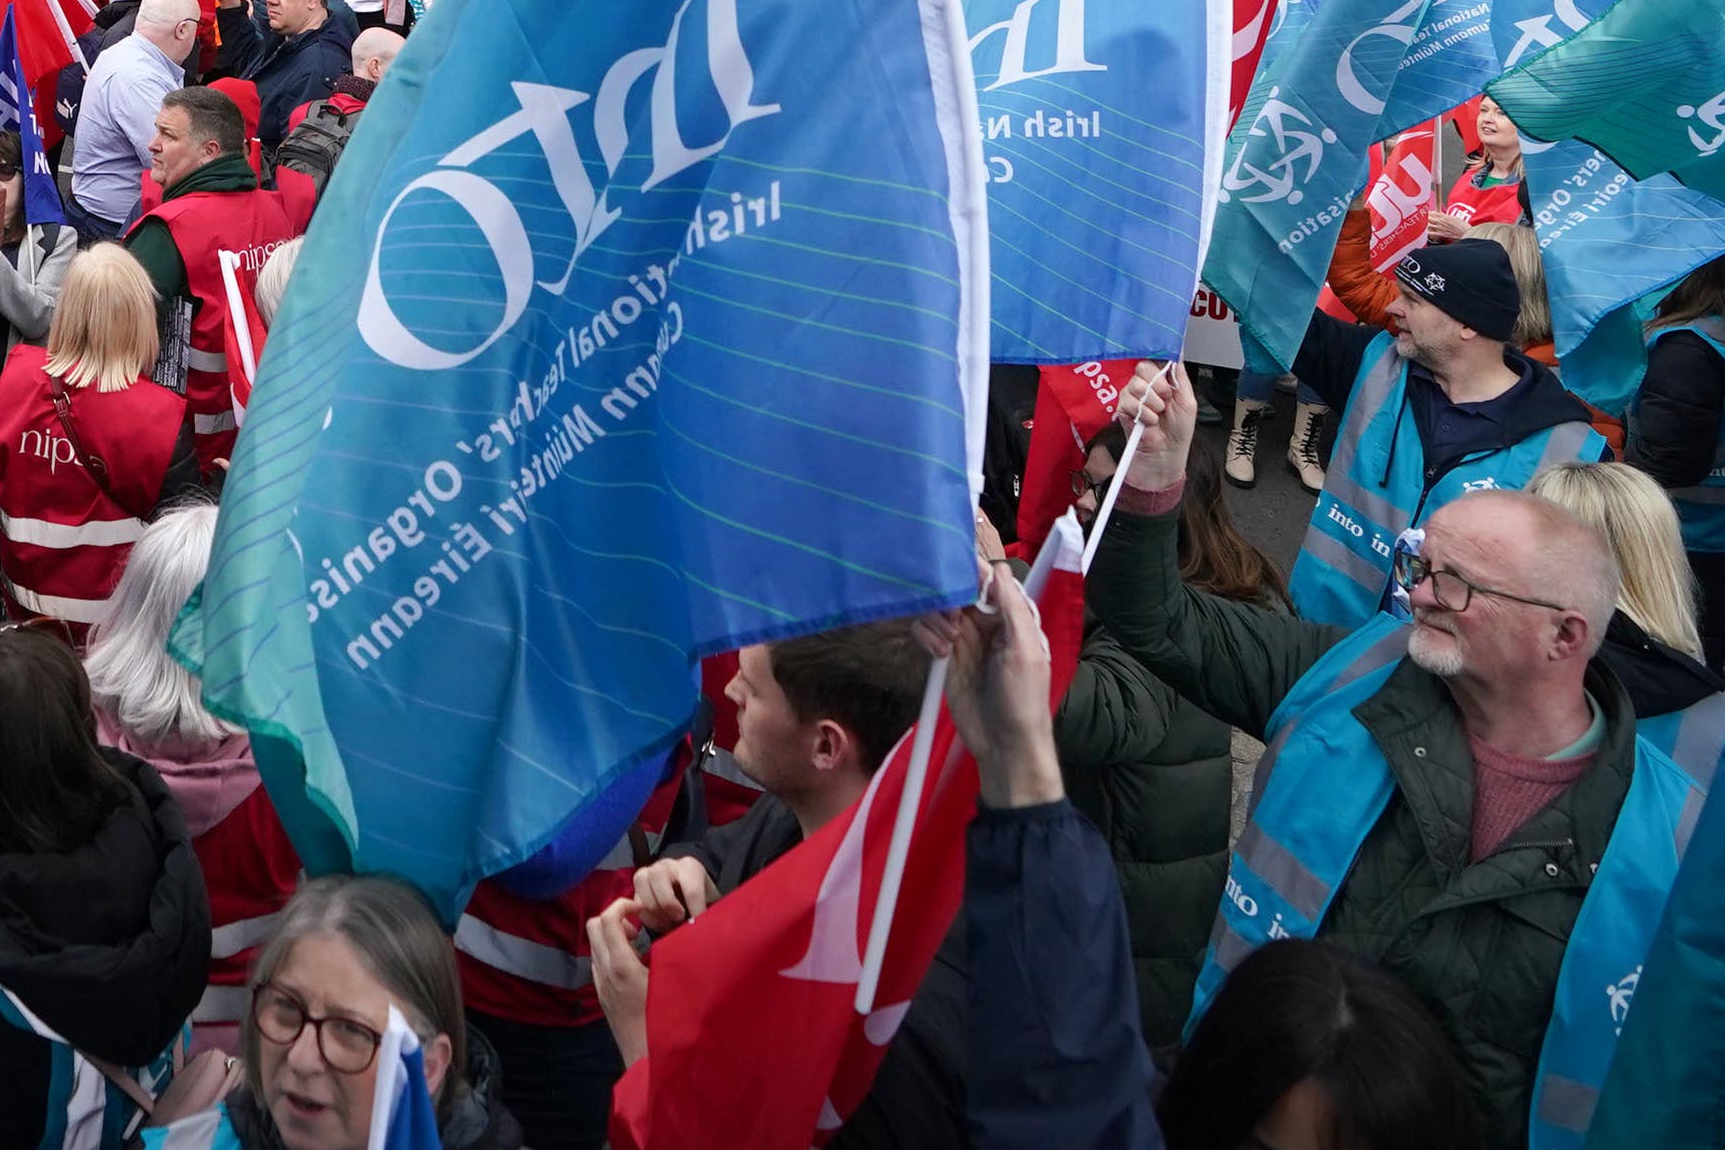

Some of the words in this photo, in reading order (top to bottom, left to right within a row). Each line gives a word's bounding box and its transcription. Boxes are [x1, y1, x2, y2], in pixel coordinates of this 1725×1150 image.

[1189, 289, 1238, 323] CU
[18, 427, 108, 474] nip
[1327, 503, 1364, 539] into
[1371, 532, 1392, 559] in
